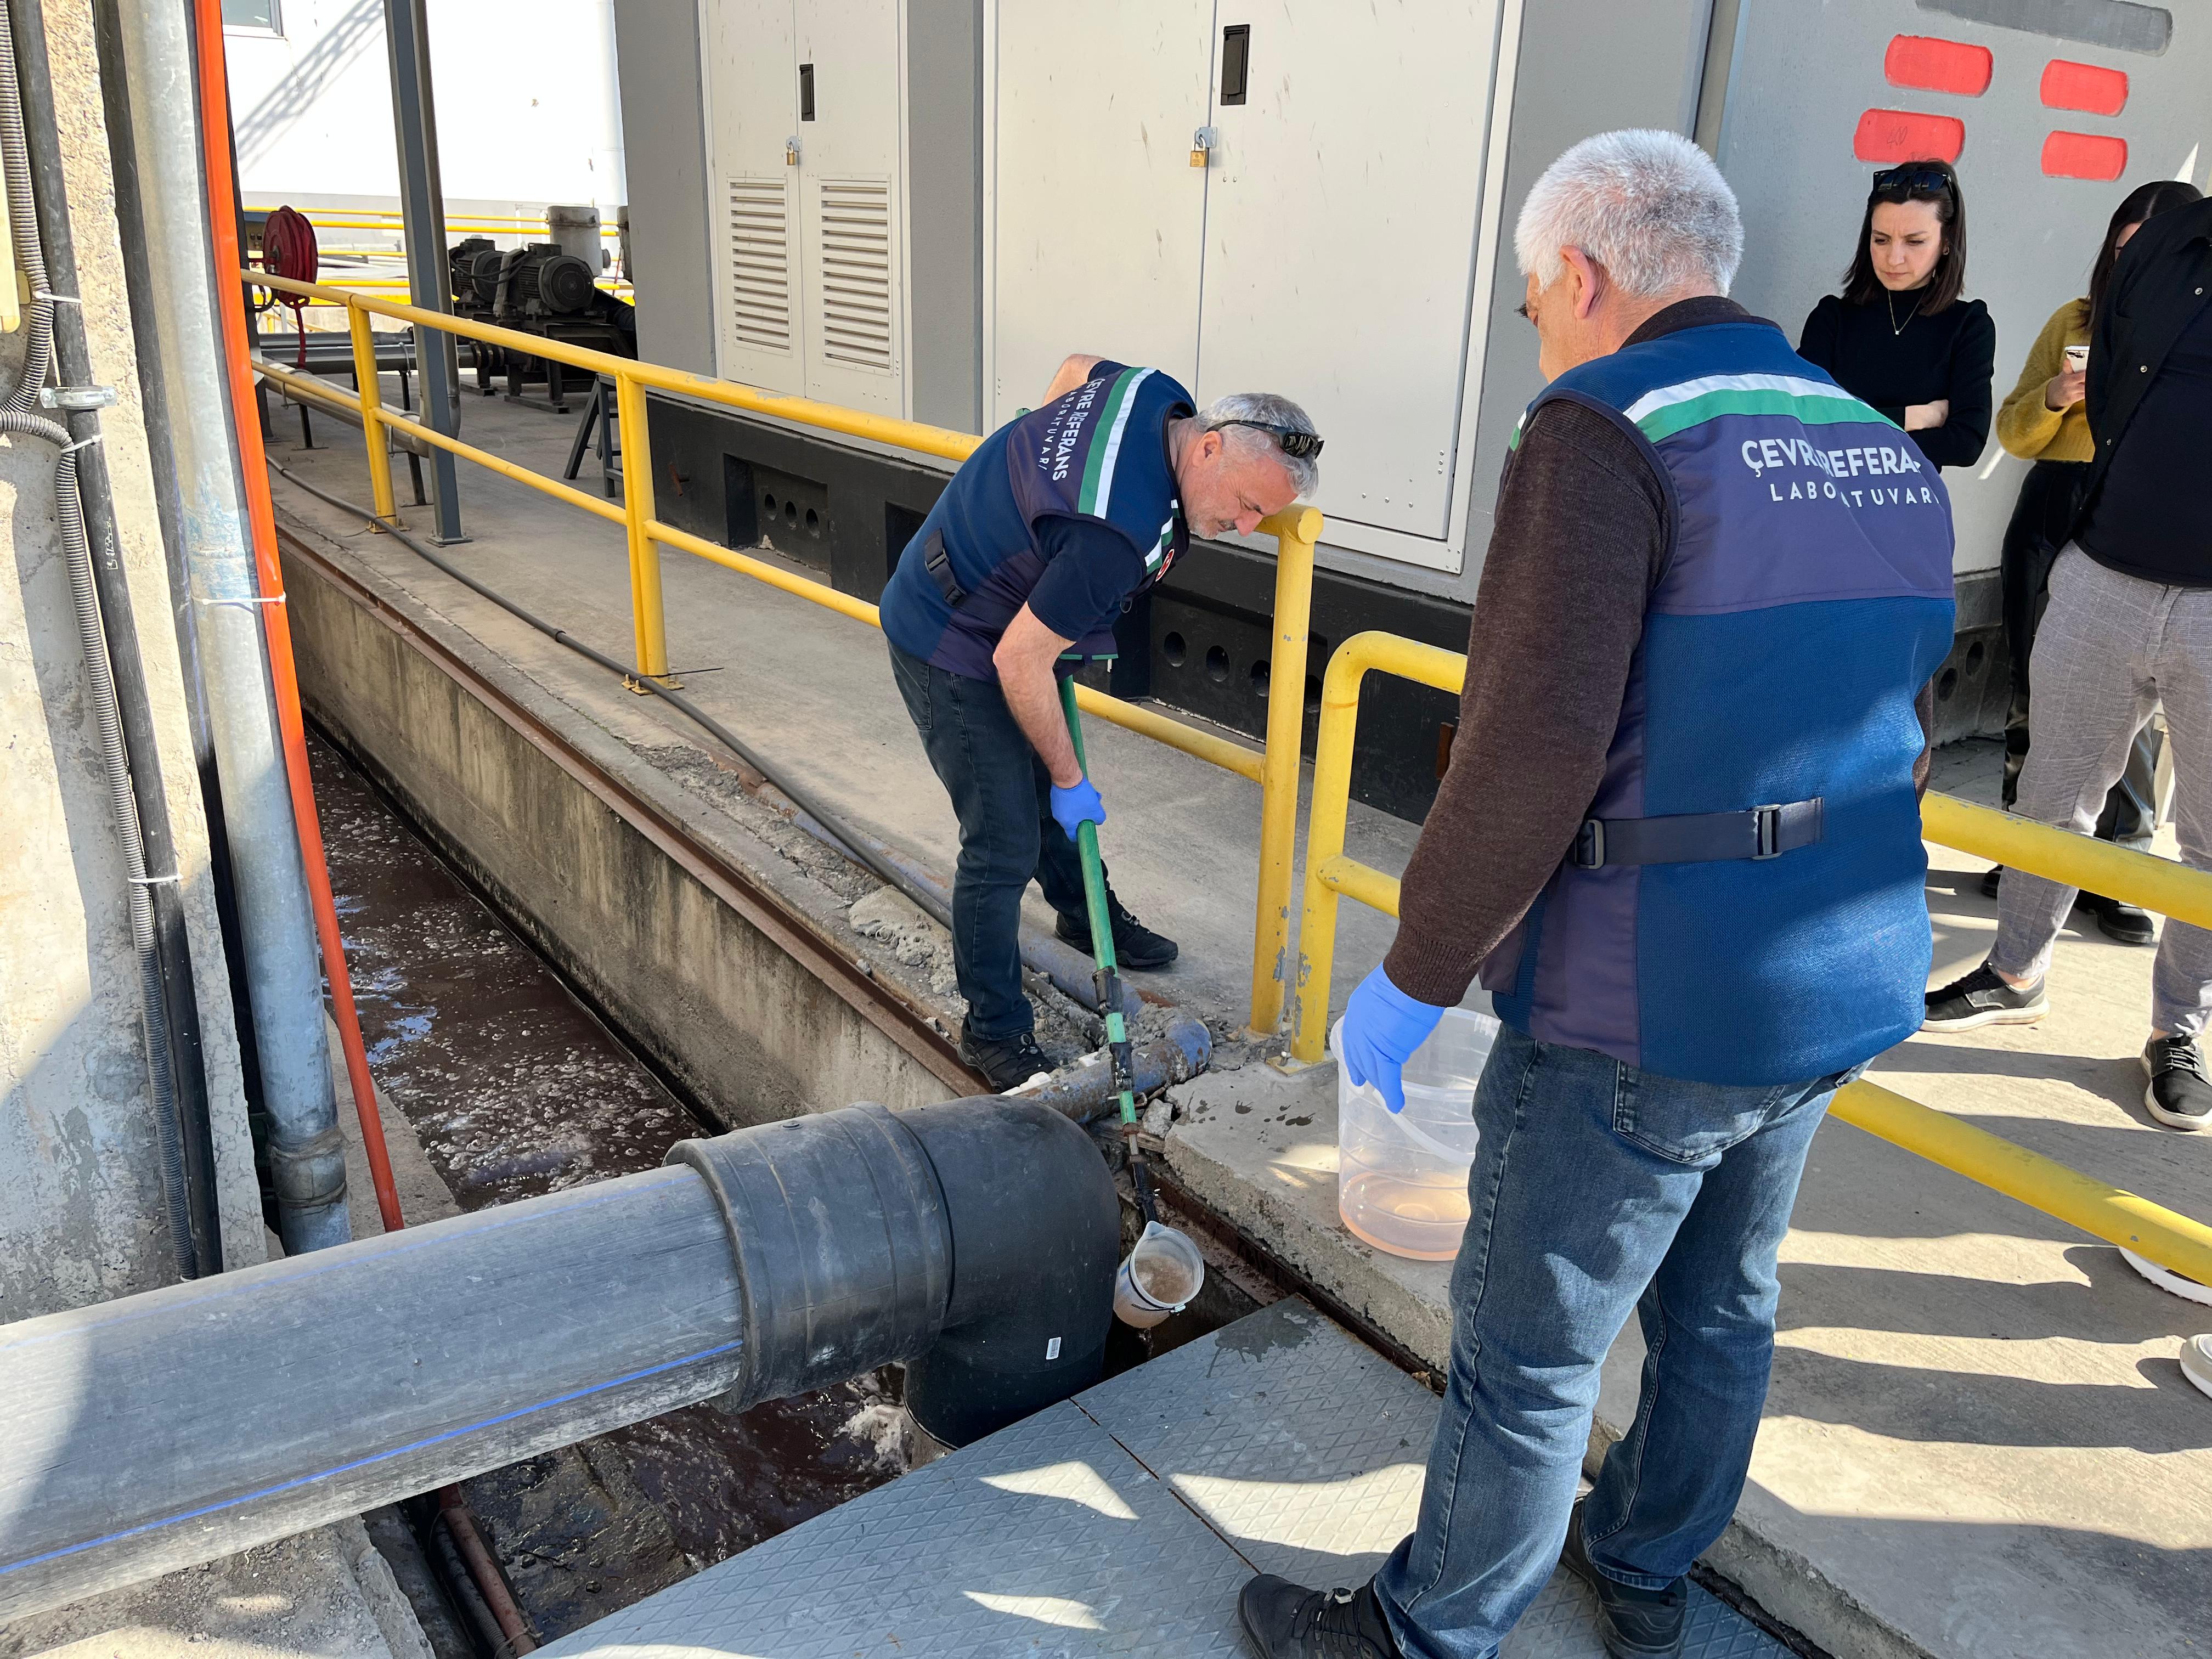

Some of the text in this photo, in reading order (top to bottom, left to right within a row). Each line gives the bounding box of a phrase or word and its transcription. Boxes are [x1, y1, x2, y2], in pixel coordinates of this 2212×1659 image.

[1038, 387, 1081, 470] ABORATUVARI
[1052, 411, 1089, 481] REFERANS
[1741, 438, 1921, 478] ÇEVR REFERA
[1770, 481, 1939, 508] LABOTUVARI
